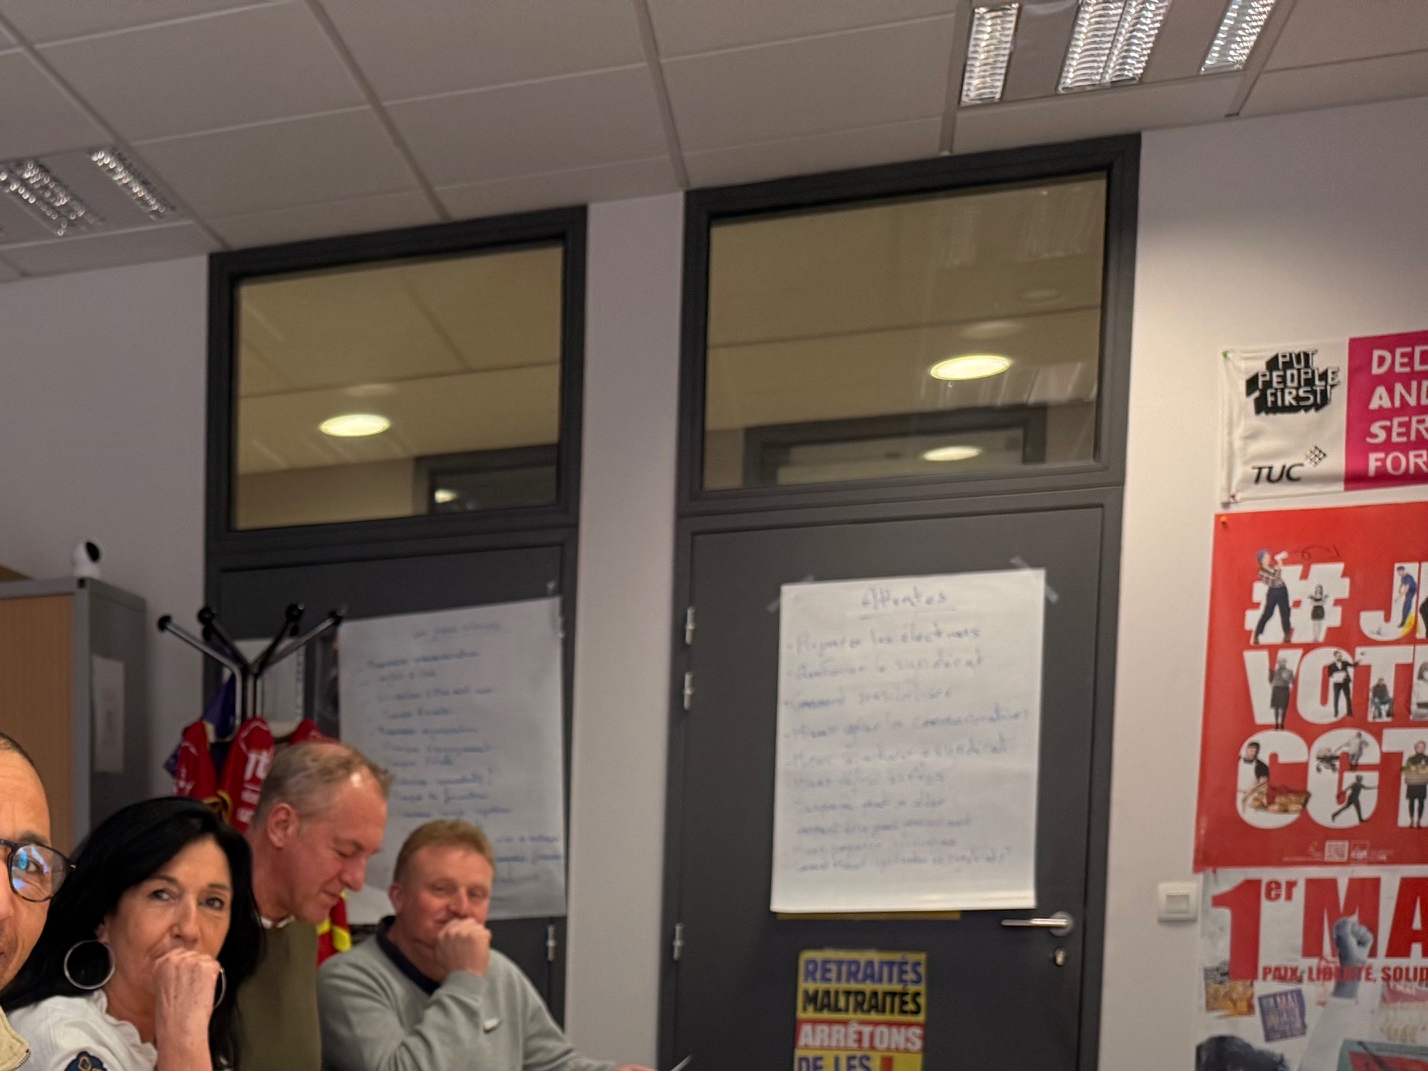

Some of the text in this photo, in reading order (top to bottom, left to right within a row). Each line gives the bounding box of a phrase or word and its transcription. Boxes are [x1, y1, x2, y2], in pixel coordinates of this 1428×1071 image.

[1278, 351, 1317, 369] PUT
[1257, 368, 1340, 390] PEOPLE
[1252, 463, 1305, 485] TUC
[803, 954, 924, 985] RETRAITÉS
[802, 984, 922, 1015] MALTRAITÉS
[798, 1020, 923, 1051] ARRÊTONS
